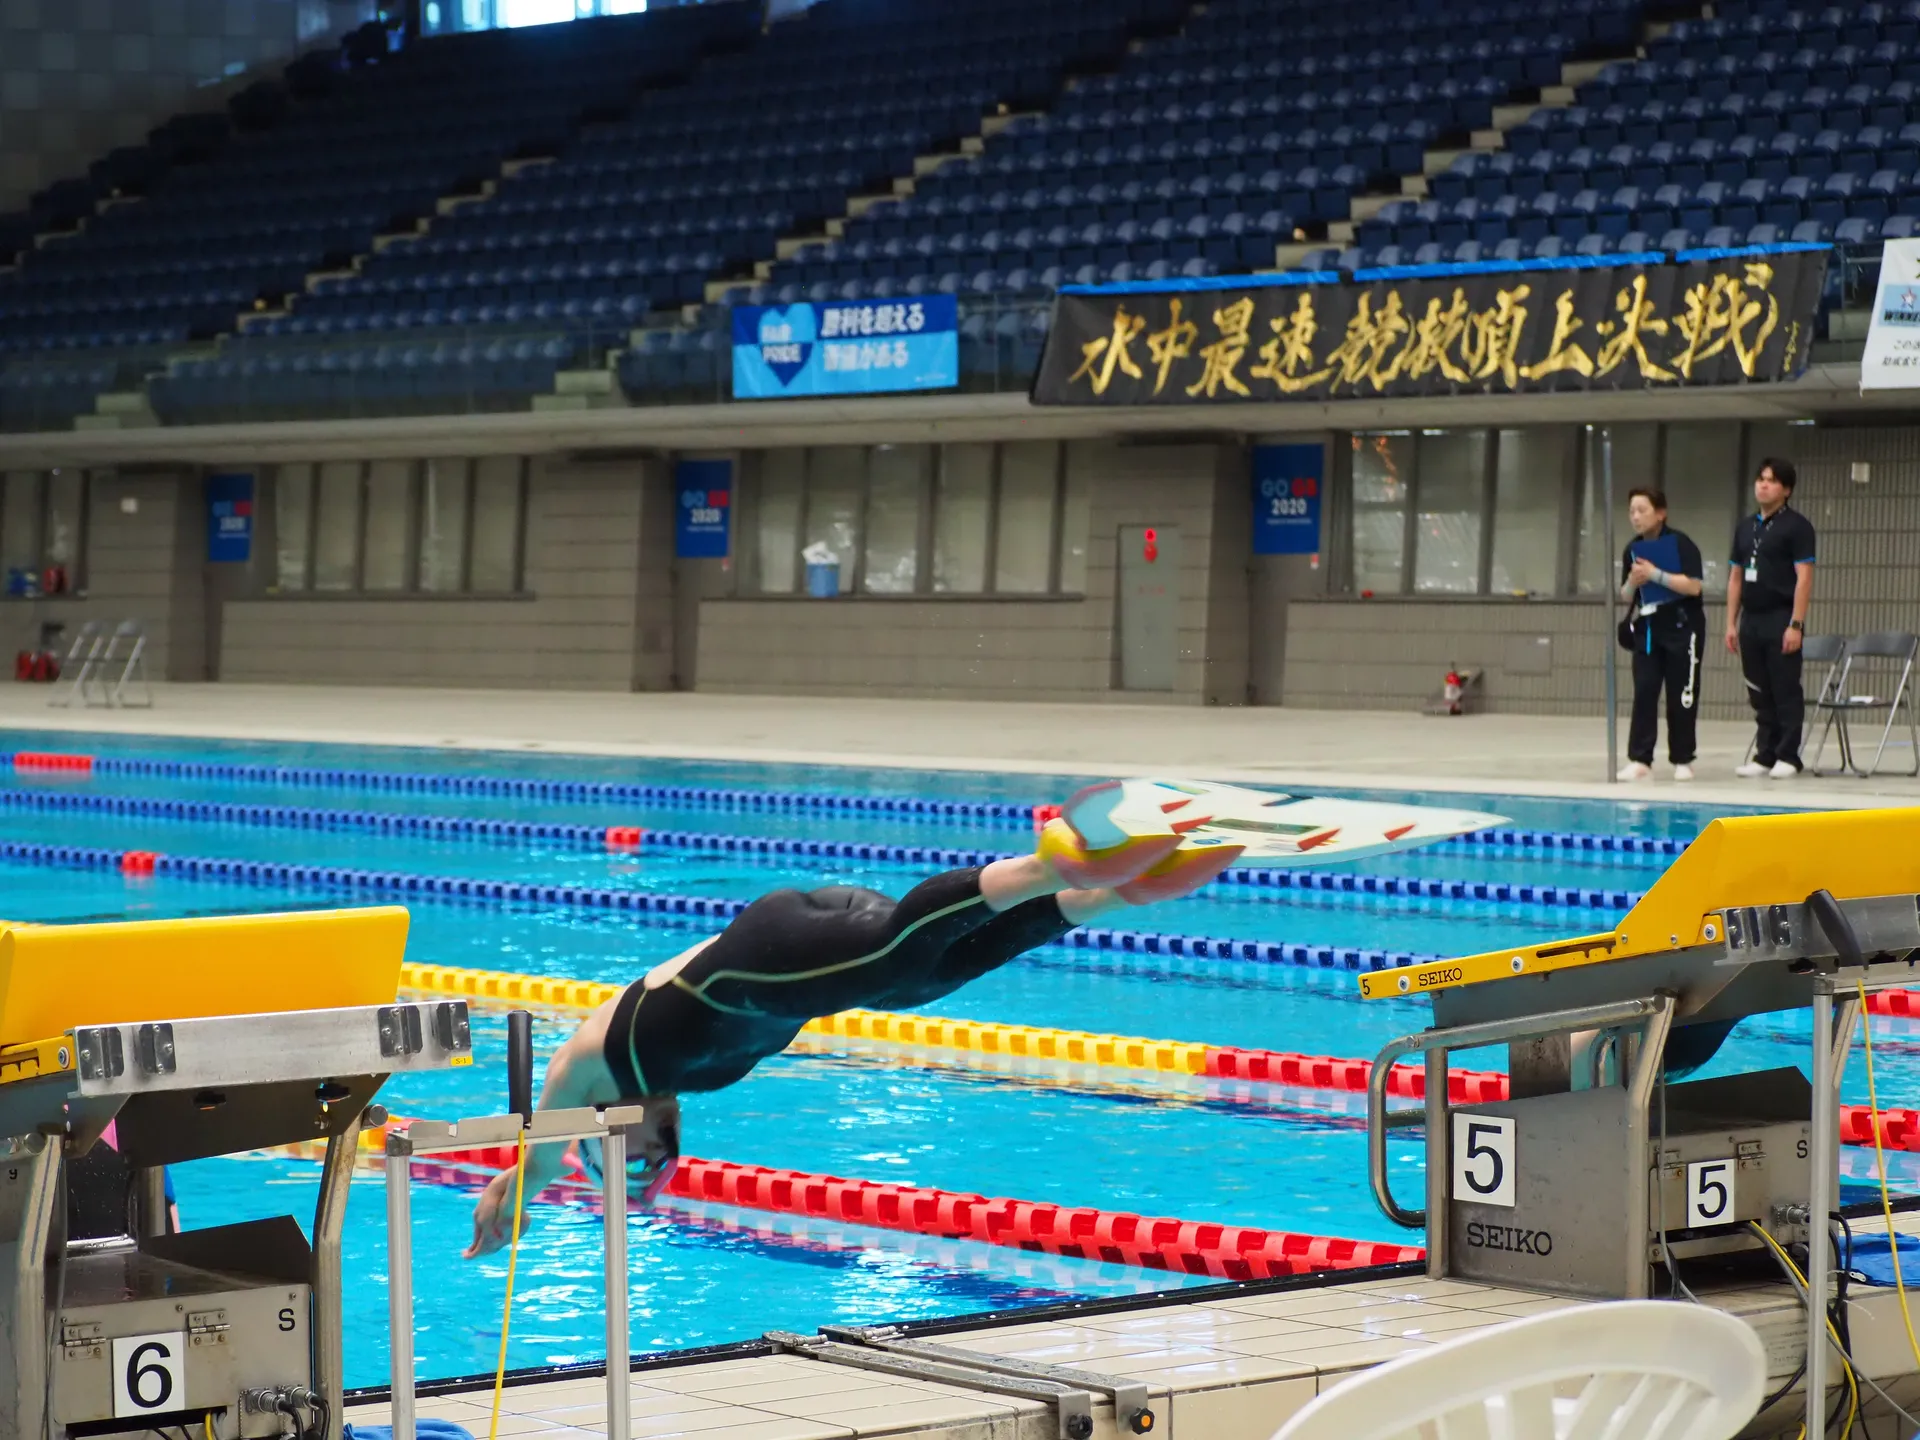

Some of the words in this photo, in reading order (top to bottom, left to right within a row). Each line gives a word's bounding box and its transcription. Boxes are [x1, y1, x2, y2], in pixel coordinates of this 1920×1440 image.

[1361, 978, 1371, 996] 5
[1418, 967, 1463, 987] SEIKO
[1464, 1122, 1504, 1194] 5
[1796, 1139, 1809, 1159] S
[1697, 1164, 1728, 1219] 5
[1466, 1221, 1553, 1257] SEIKO
[278, 1308, 296, 1332] S
[126, 1341, 173, 1409] 6
